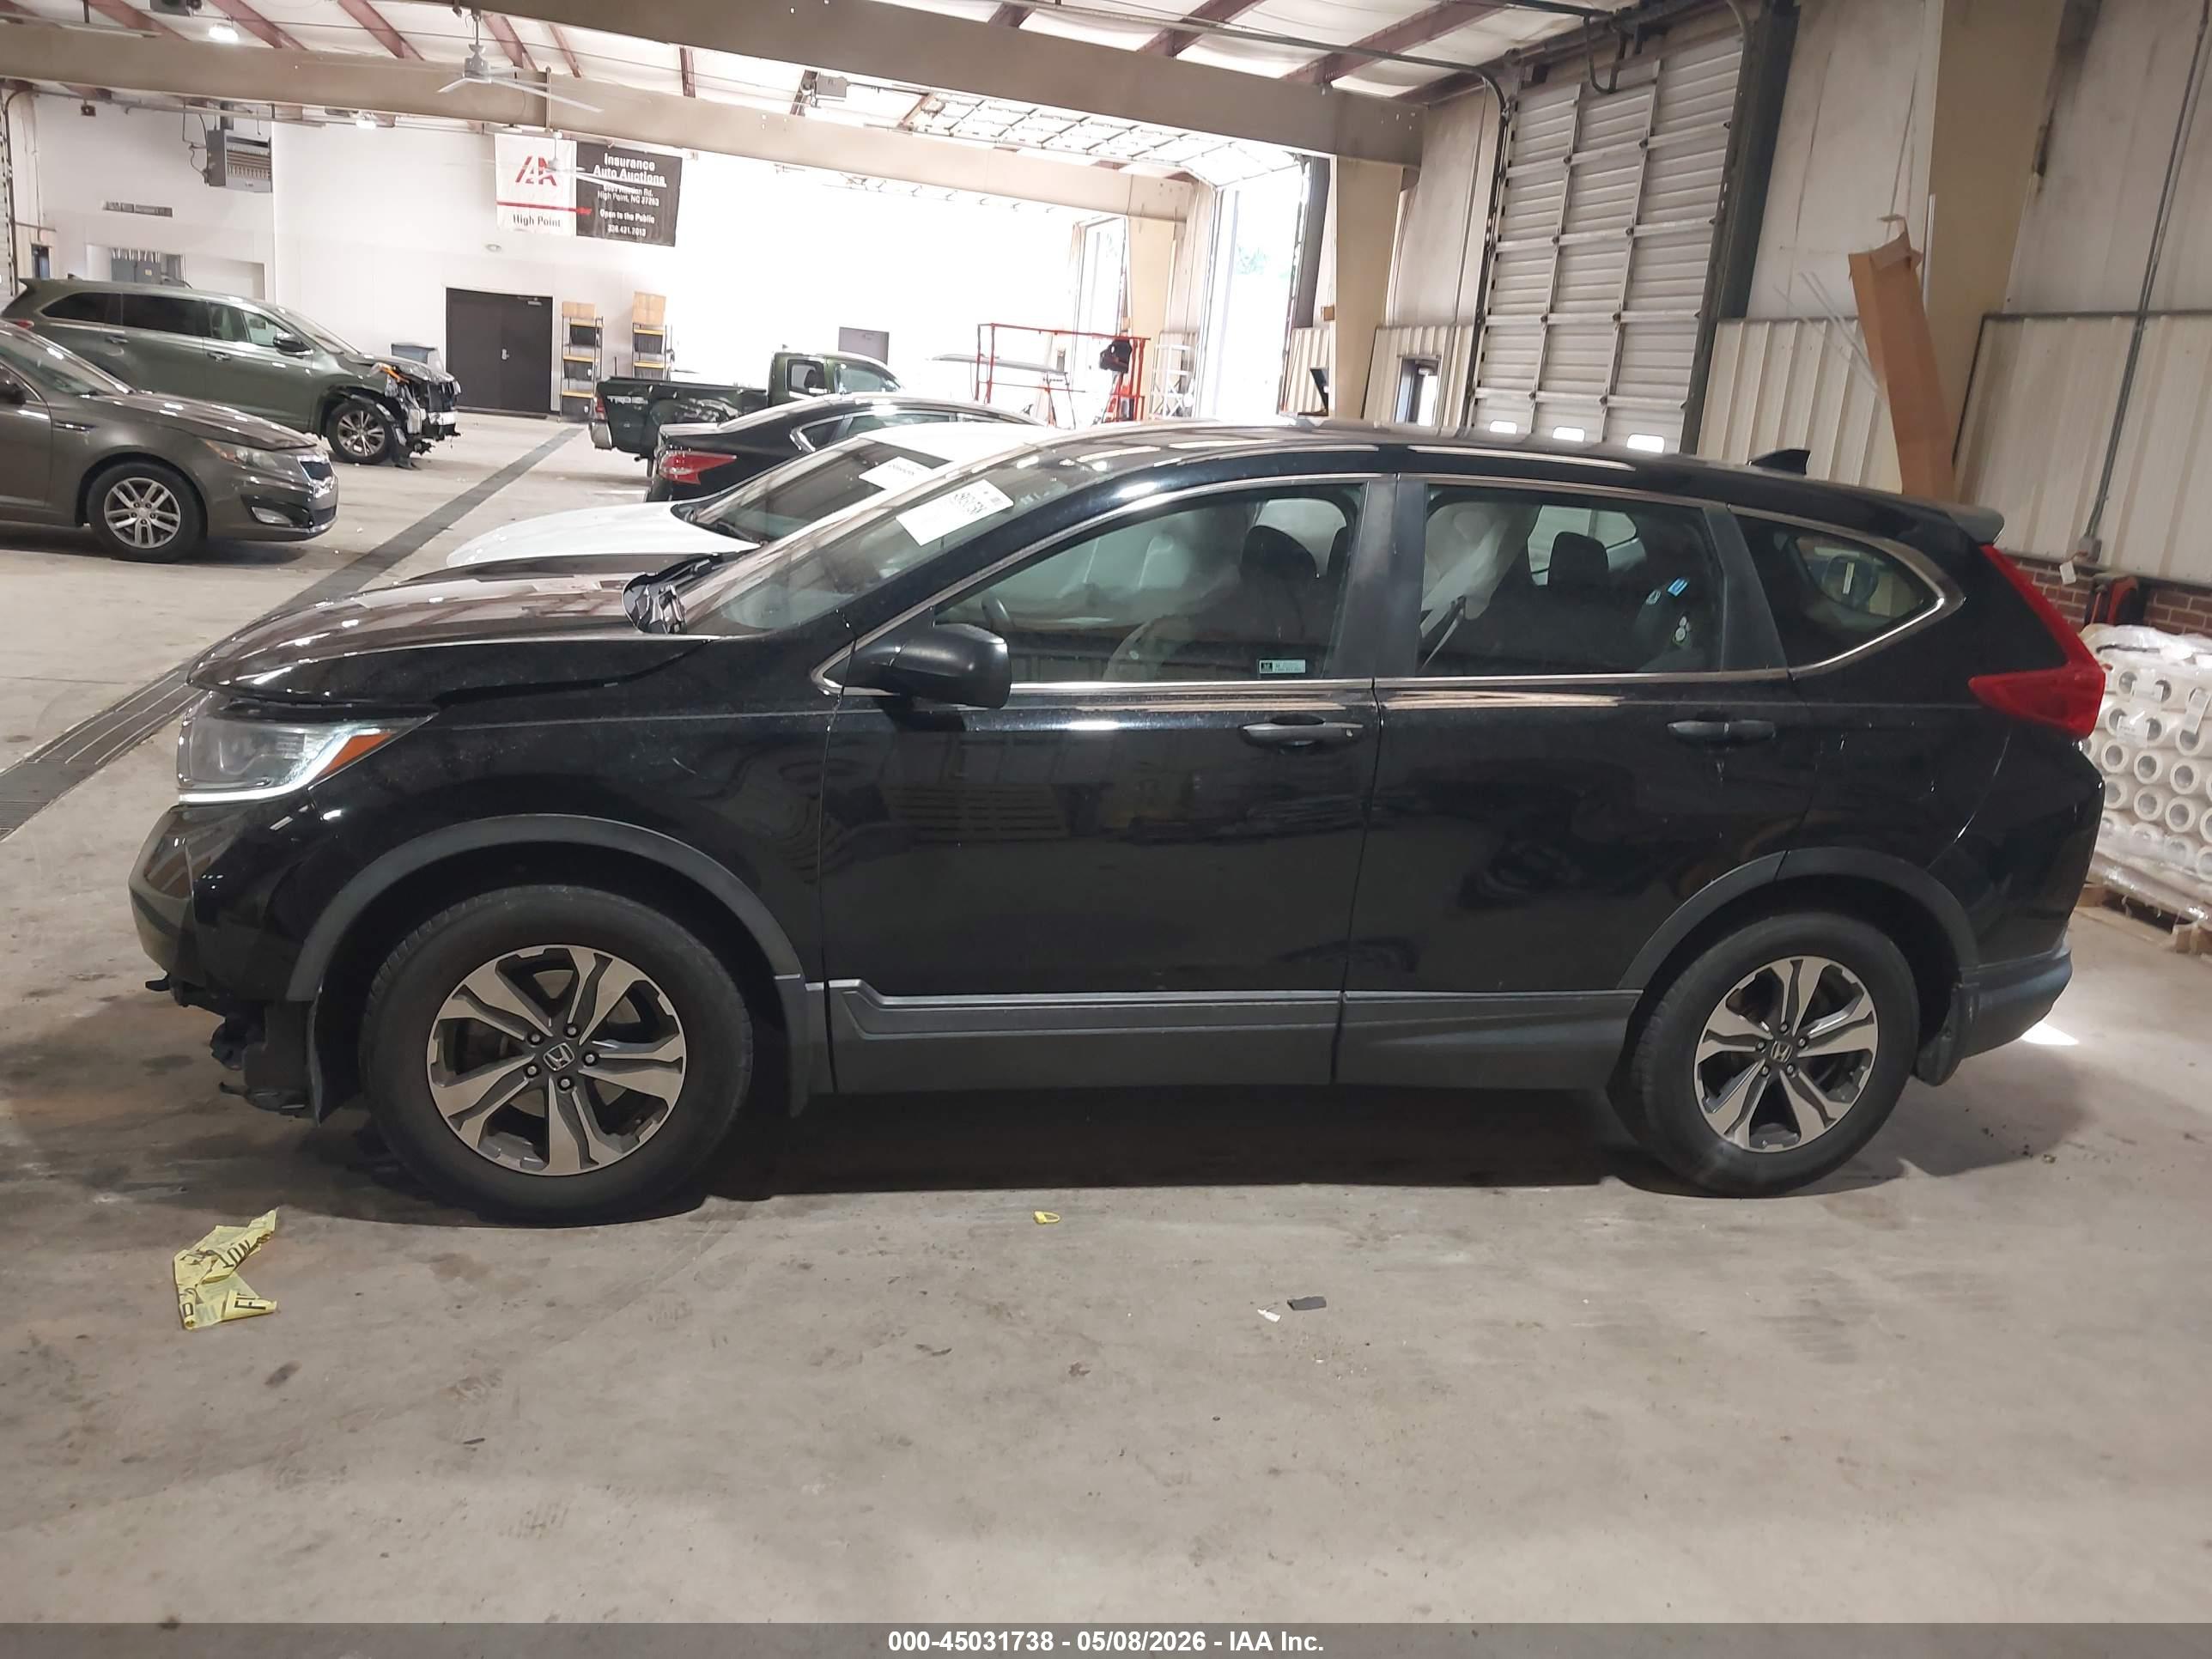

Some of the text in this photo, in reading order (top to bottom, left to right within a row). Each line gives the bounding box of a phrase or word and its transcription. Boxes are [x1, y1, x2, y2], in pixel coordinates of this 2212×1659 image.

[605, 152, 655, 172] Insurance
[593, 164, 617, 179] Auto
[598, 190, 611, 201] High
[631, 194, 641, 204] NC
[513, 214, 534, 227] High
[599, 209, 616, 219] Open
[624, 212, 634, 221] the
[635, 213, 655, 223] Public
